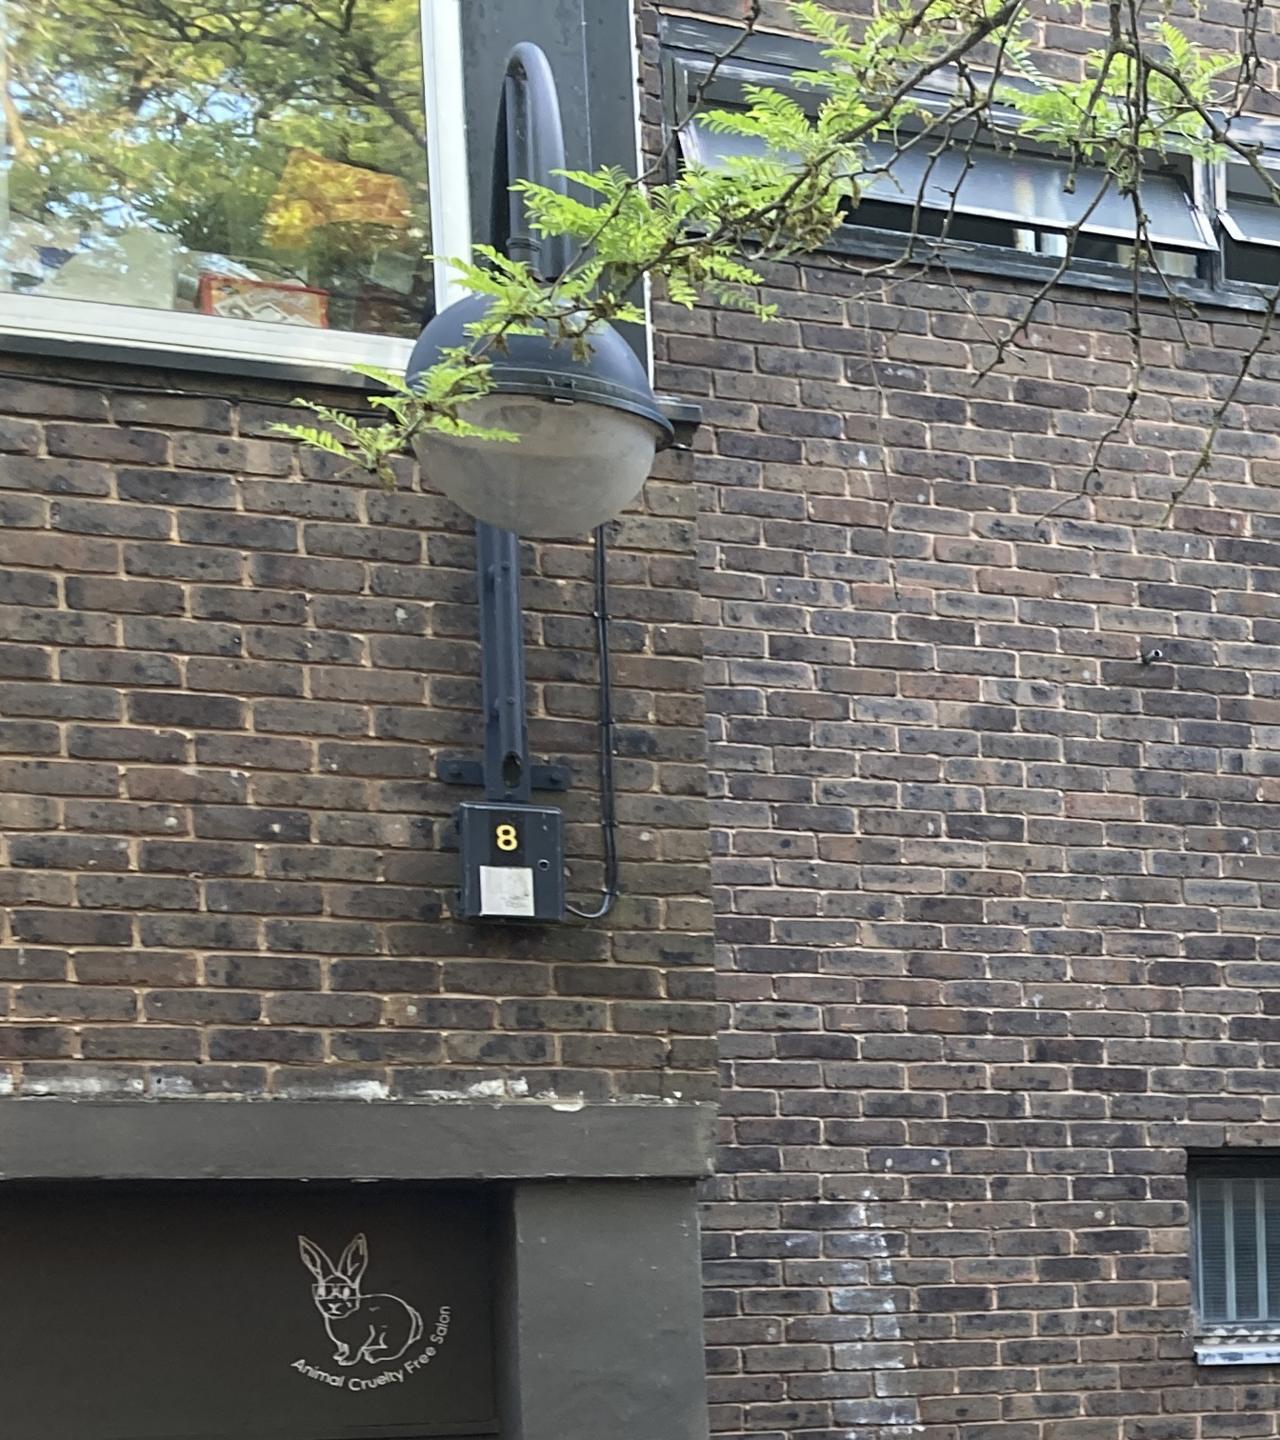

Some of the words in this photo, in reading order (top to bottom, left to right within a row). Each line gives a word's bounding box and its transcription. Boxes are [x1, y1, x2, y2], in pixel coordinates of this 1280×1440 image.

[496, 824, 518, 851] 8
[290, 1359, 345, 1387] Animal
[348, 1369, 404, 1391] Cruelty
[403, 1346, 437, 1374] Free
[430, 1305, 451, 1345] Salon
